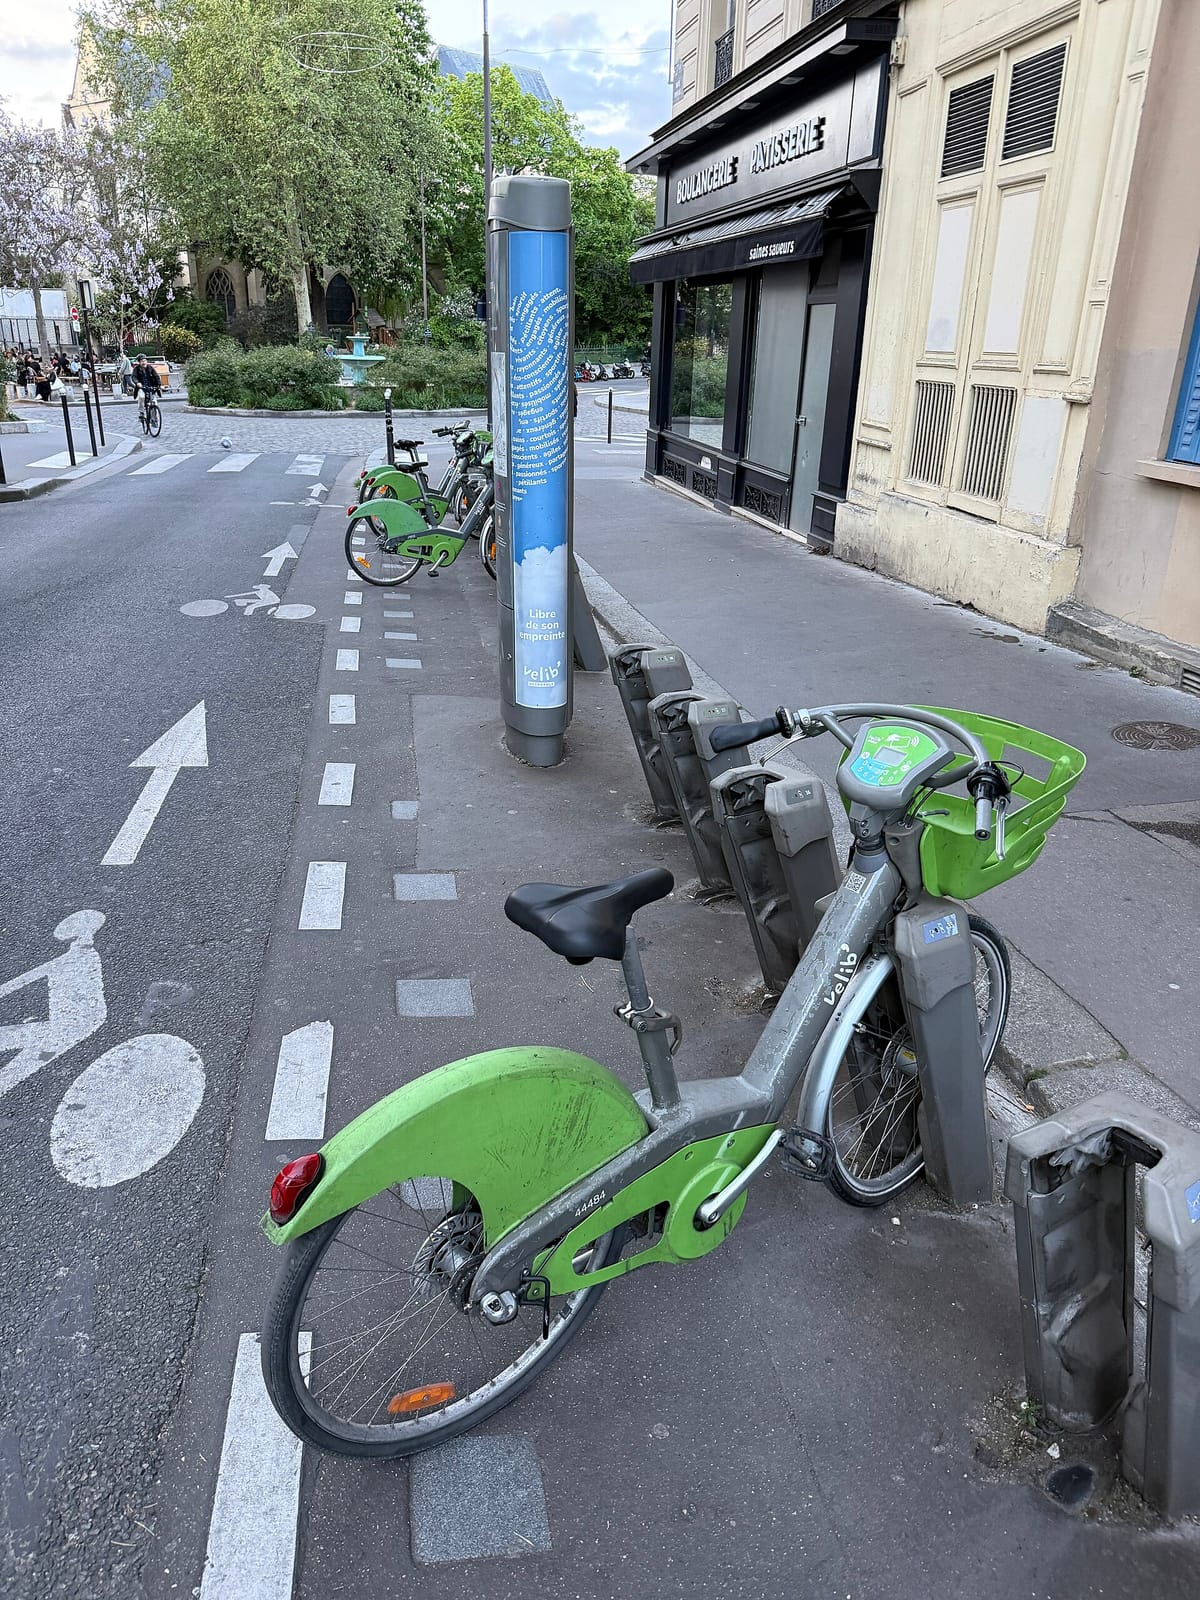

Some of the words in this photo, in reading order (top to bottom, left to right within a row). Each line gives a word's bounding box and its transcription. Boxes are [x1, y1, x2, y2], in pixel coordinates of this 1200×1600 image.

[676, 155, 738, 204] BOULANGERIE
[751, 116, 826, 174] PATISSERIE
[749, 243, 769, 260] saines
[768, 240, 795, 257] saveurs
[521, 292, 539, 321] engagés
[521, 306, 538, 343] pétillants
[526, 317, 542, 347] engagés
[537, 315, 554, 345] citoyens
[529, 370, 561, 398] passionnés
[529, 429, 557, 443] courtois
[529, 436, 560, 451] mobilisés
[543, 445, 562, 458] agiles
[526, 620, 539, 630] de
[541, 622, 559, 630] son
[529, 608, 557, 619] Libre
[519, 631, 566, 643] empreinte
[574, 1189, 606, 1217] 44484
